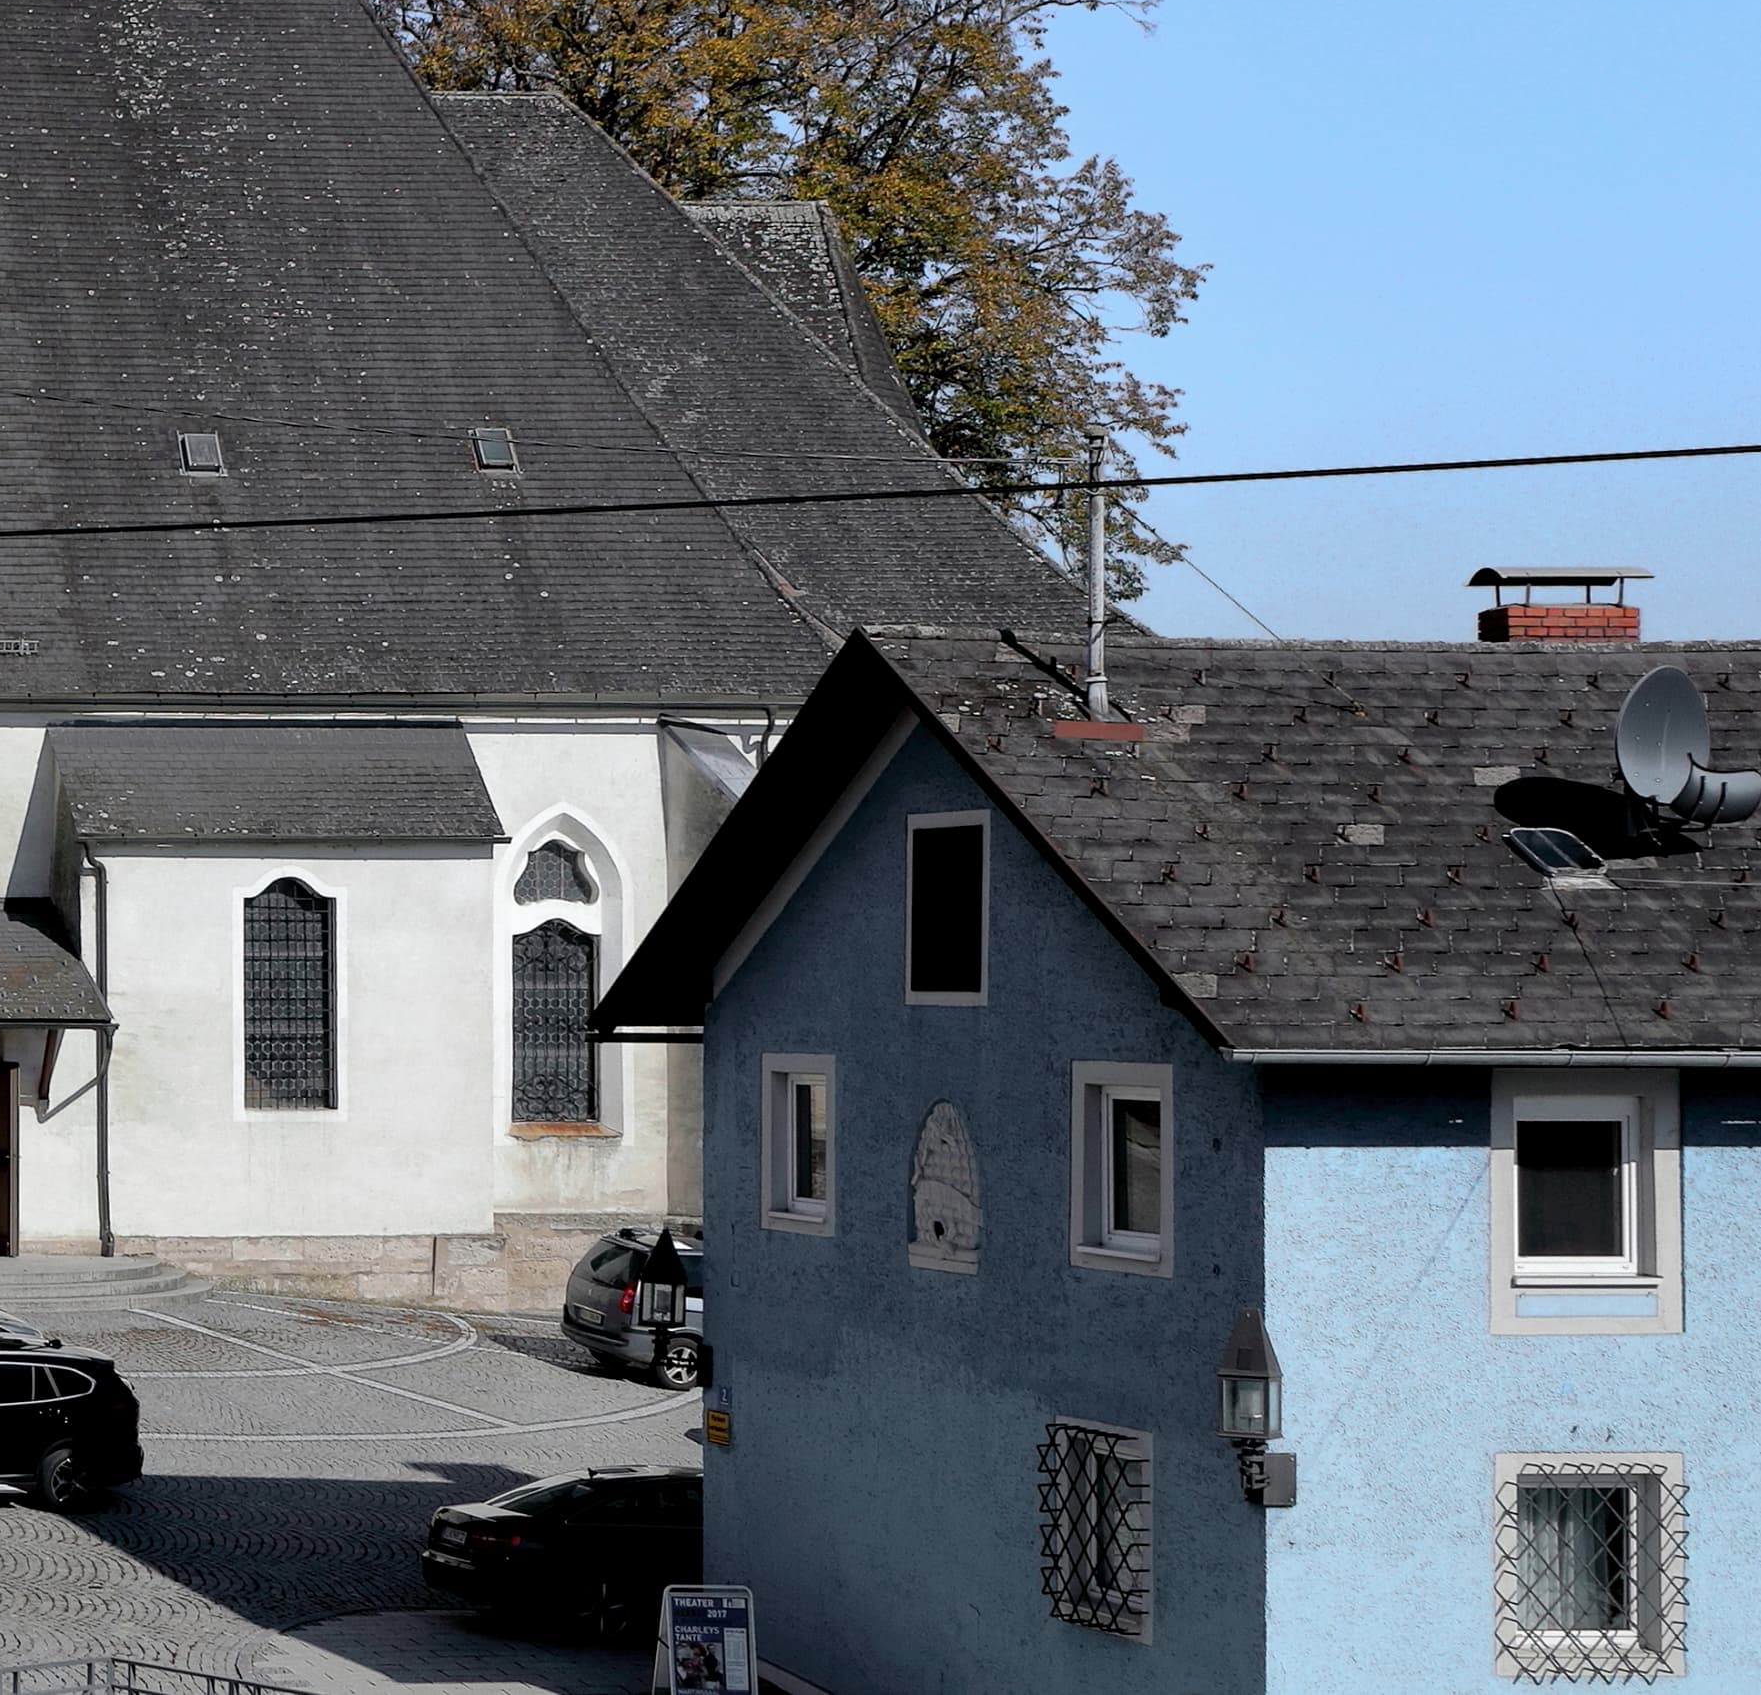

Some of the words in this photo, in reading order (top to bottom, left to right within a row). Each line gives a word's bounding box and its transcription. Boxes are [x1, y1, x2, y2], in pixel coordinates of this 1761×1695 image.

[721, 1388, 728, 1402] 2
[674, 1598, 714, 1608] THEATER
[707, 1609, 727, 1618] 2017
[675, 1626, 720, 1635] CHARLEYS
[676, 1634, 702, 1642] TANTE
